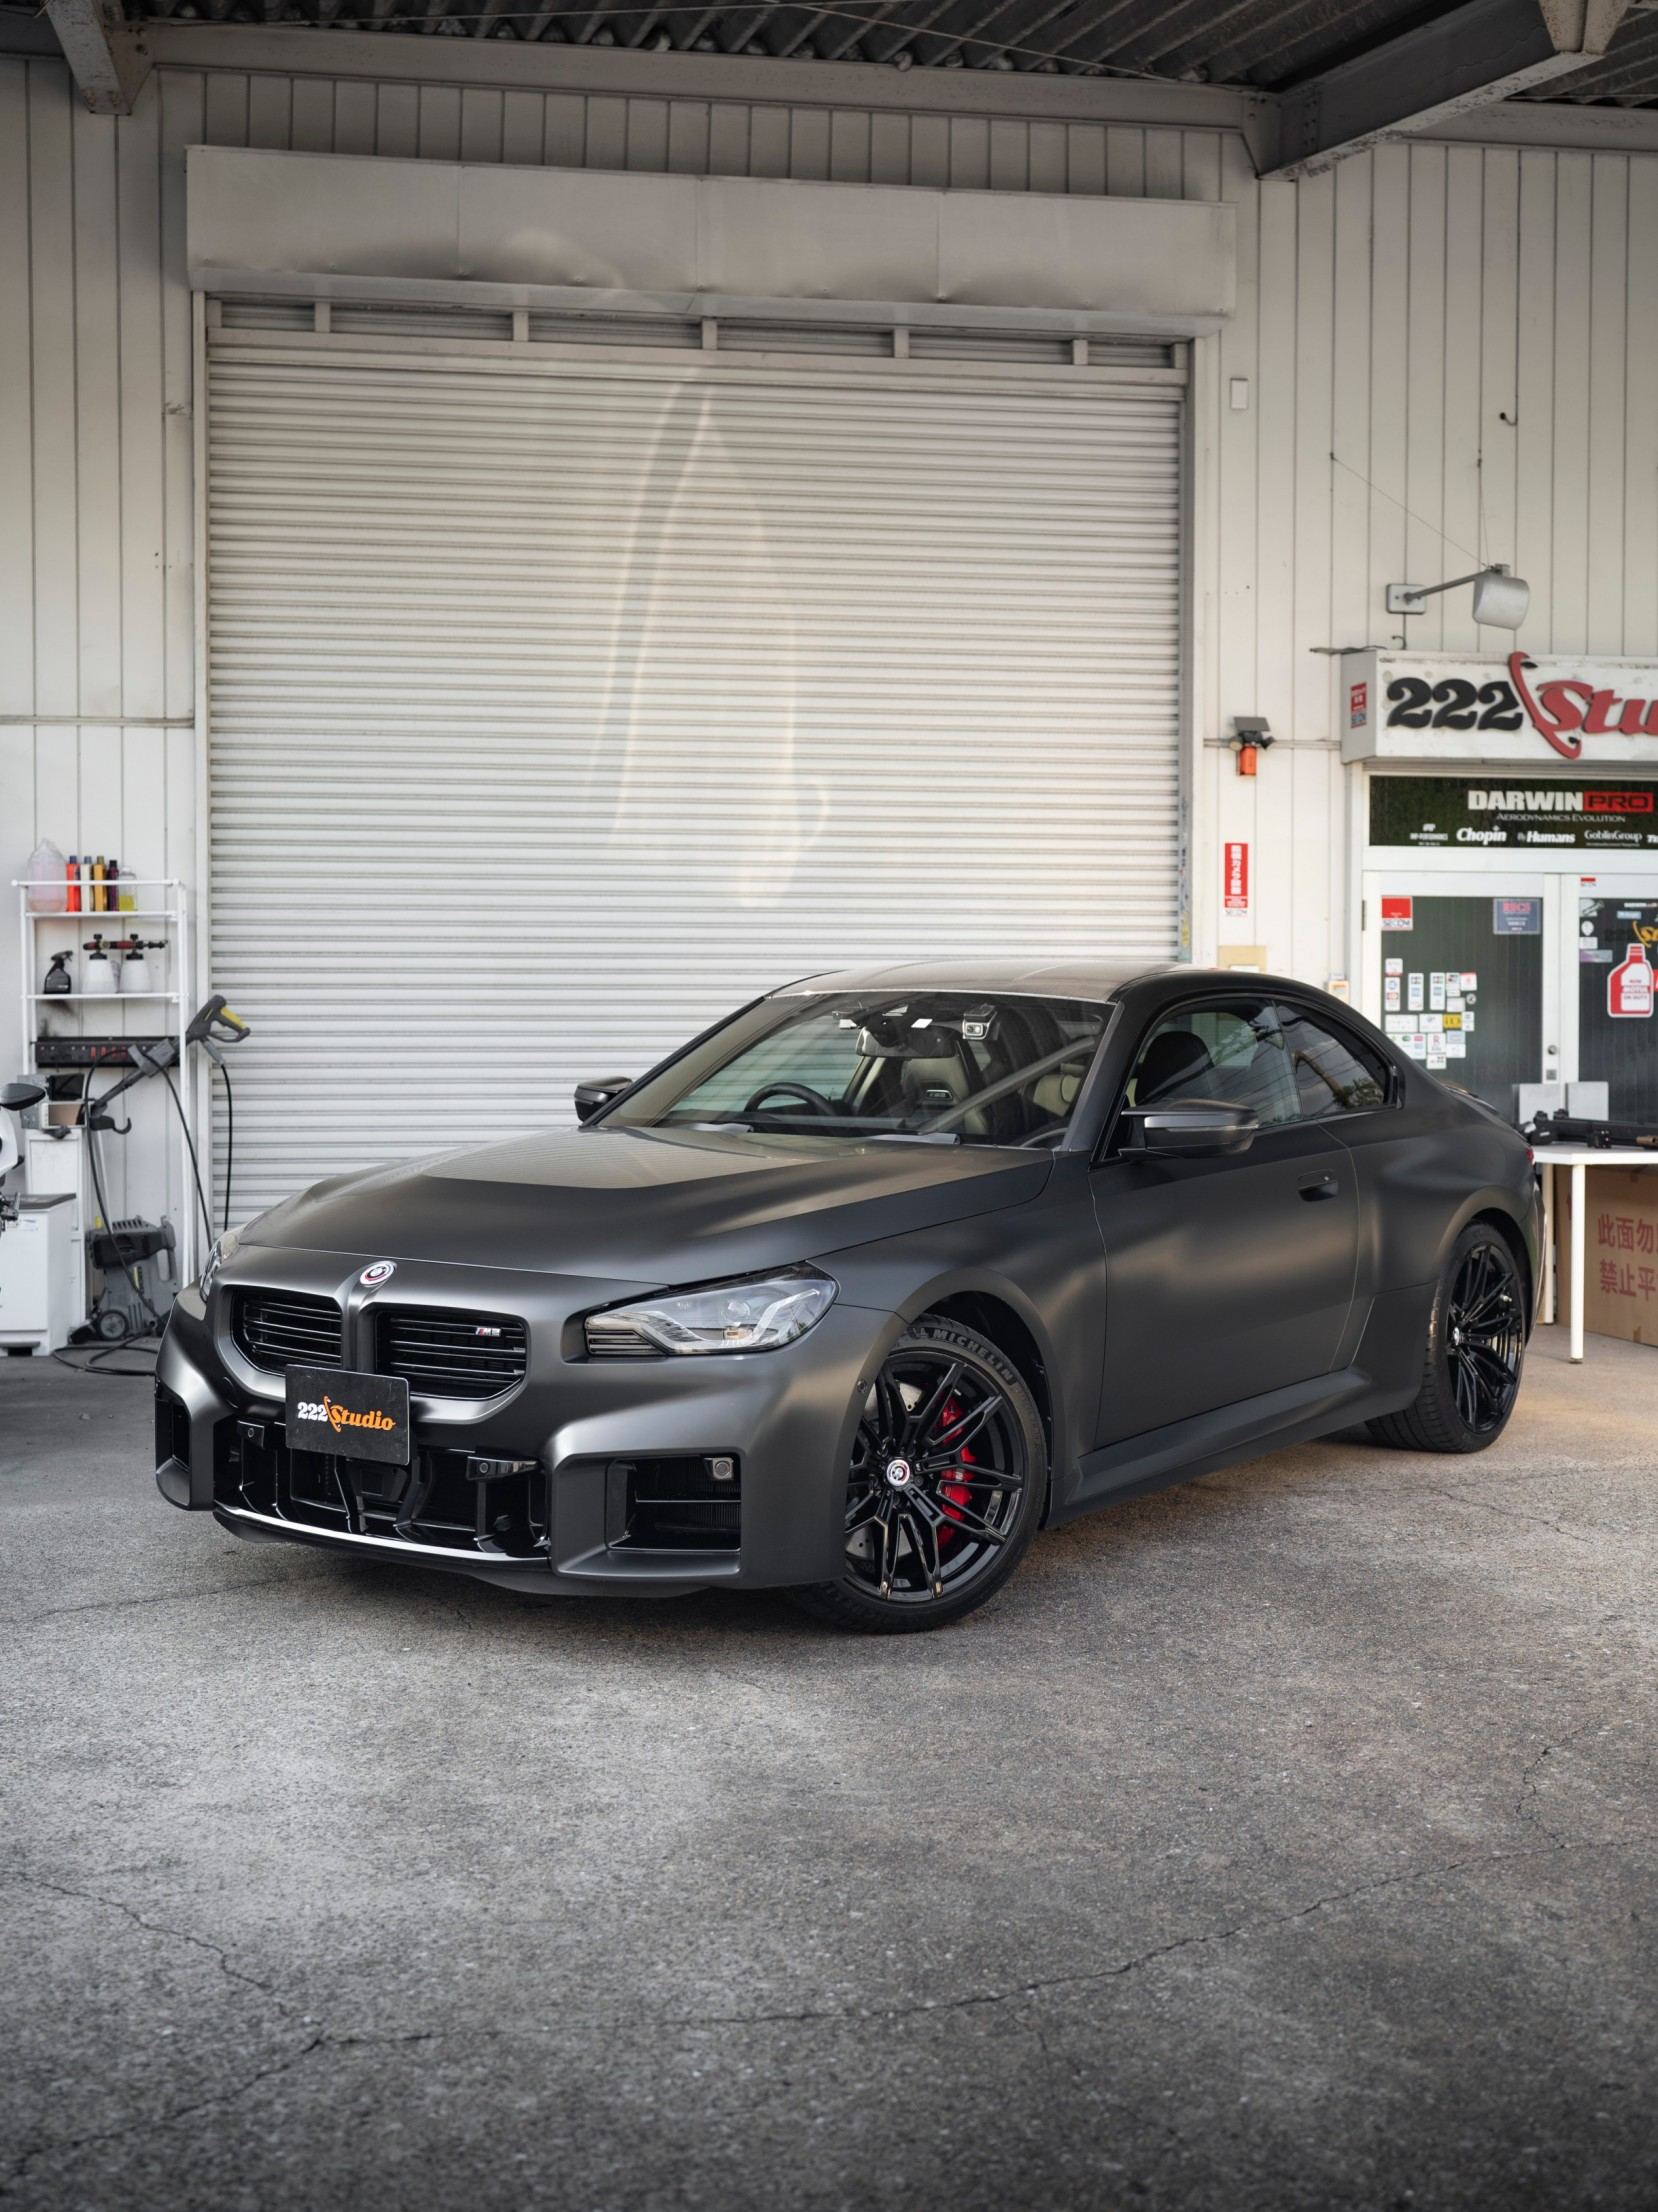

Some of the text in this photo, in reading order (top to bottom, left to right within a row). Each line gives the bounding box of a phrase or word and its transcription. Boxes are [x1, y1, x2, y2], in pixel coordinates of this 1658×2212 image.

[1387, 677, 1523, 731] 222
[1467, 790, 1649, 811] DARWIN PRO
[1456, 826, 1507, 846] Chopin
[1525, 830, 1576, 844] Humans
[1597, 1212, 1658, 1255] 此面勿
[1600, 1258, 1658, 1301] 禁止平
[933, 1328, 1014, 1380] MICHELIN
[297, 1401, 396, 1432] 222 Studio
